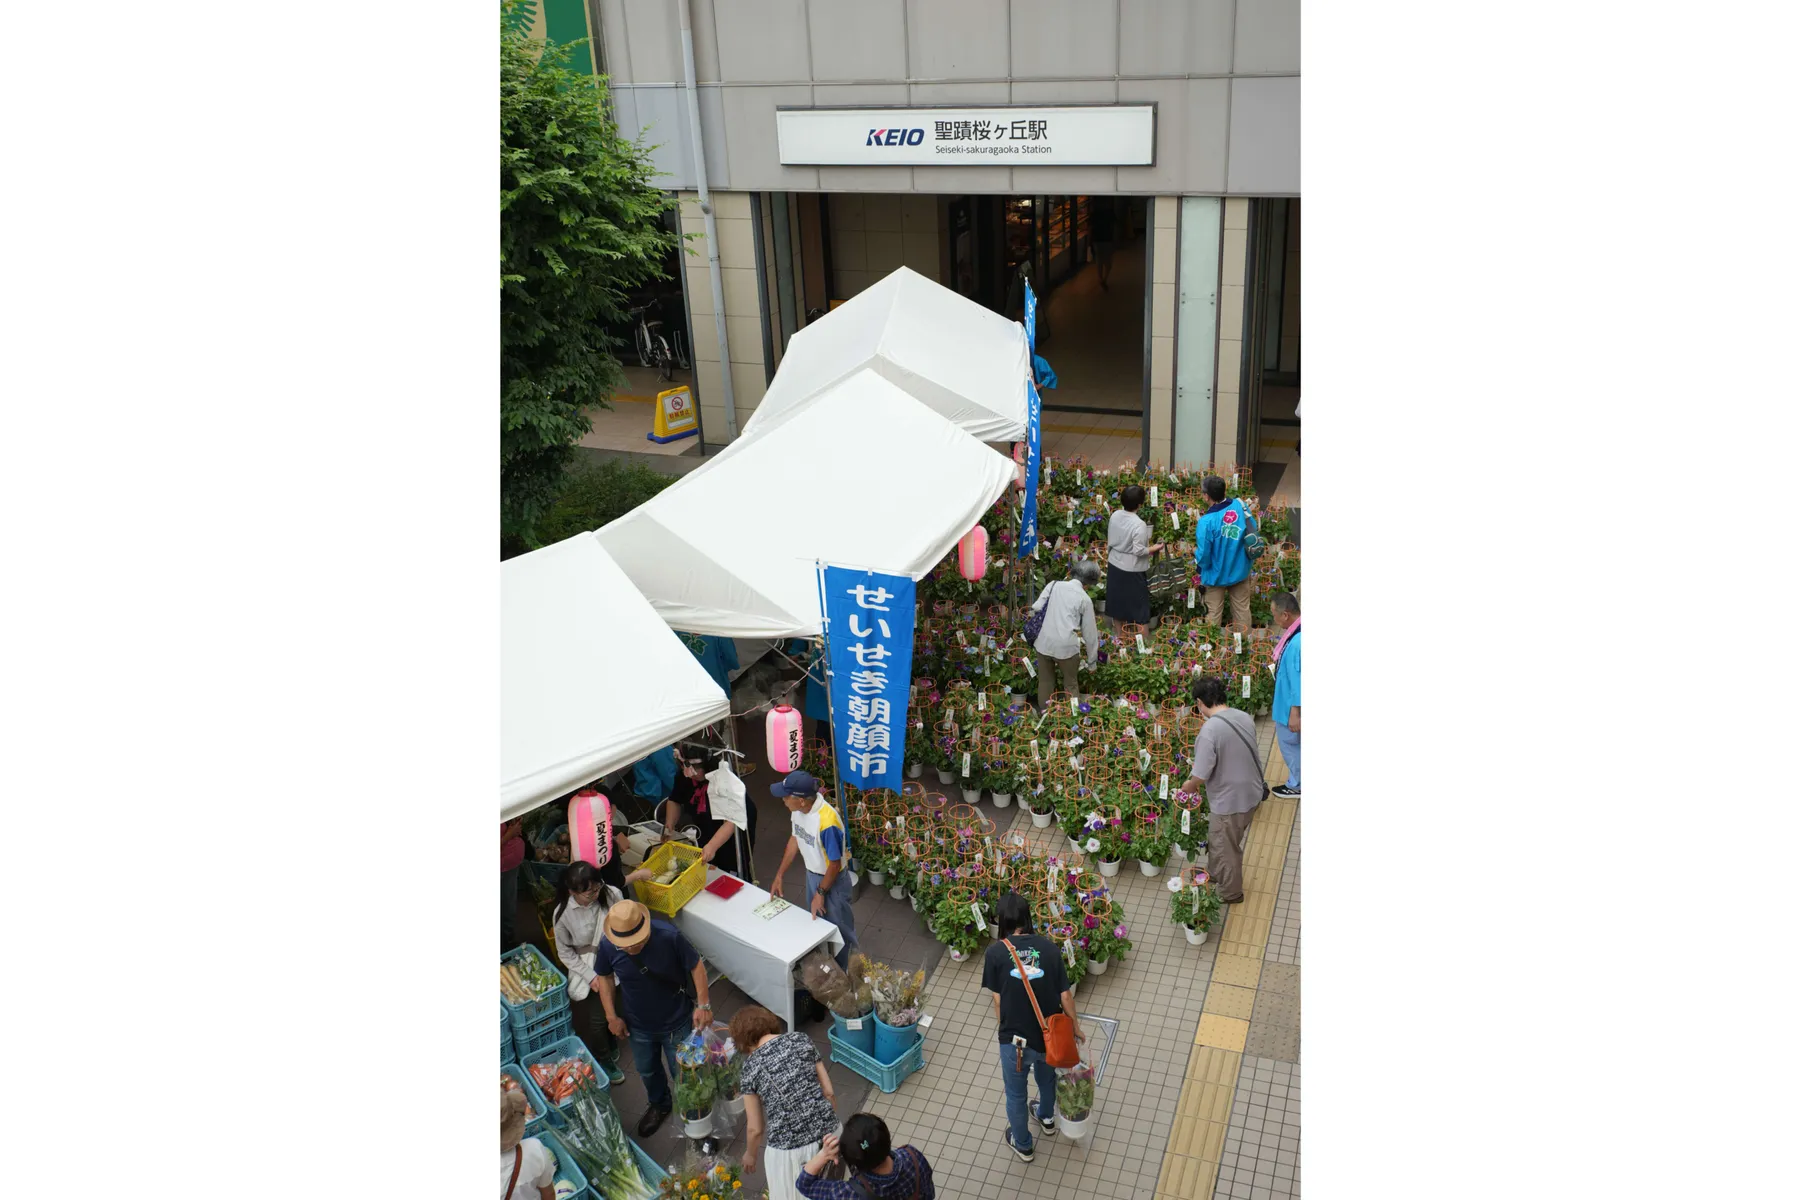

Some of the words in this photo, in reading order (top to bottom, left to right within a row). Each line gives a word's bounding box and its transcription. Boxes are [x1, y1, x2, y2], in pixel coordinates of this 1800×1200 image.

[866, 128, 925, 147] KEIO
[934, 120, 1048, 141] 聖蹟桜ヶ丘駅
[935, 145, 1019, 156] Seiseki-sakuragaoka
[1021, 145, 1052, 154] Station
[846, 584, 895, 778] せいせき朝顔市
[789, 729, 799, 769] 夏まつり
[596, 820, 608, 865] 夏まつり
